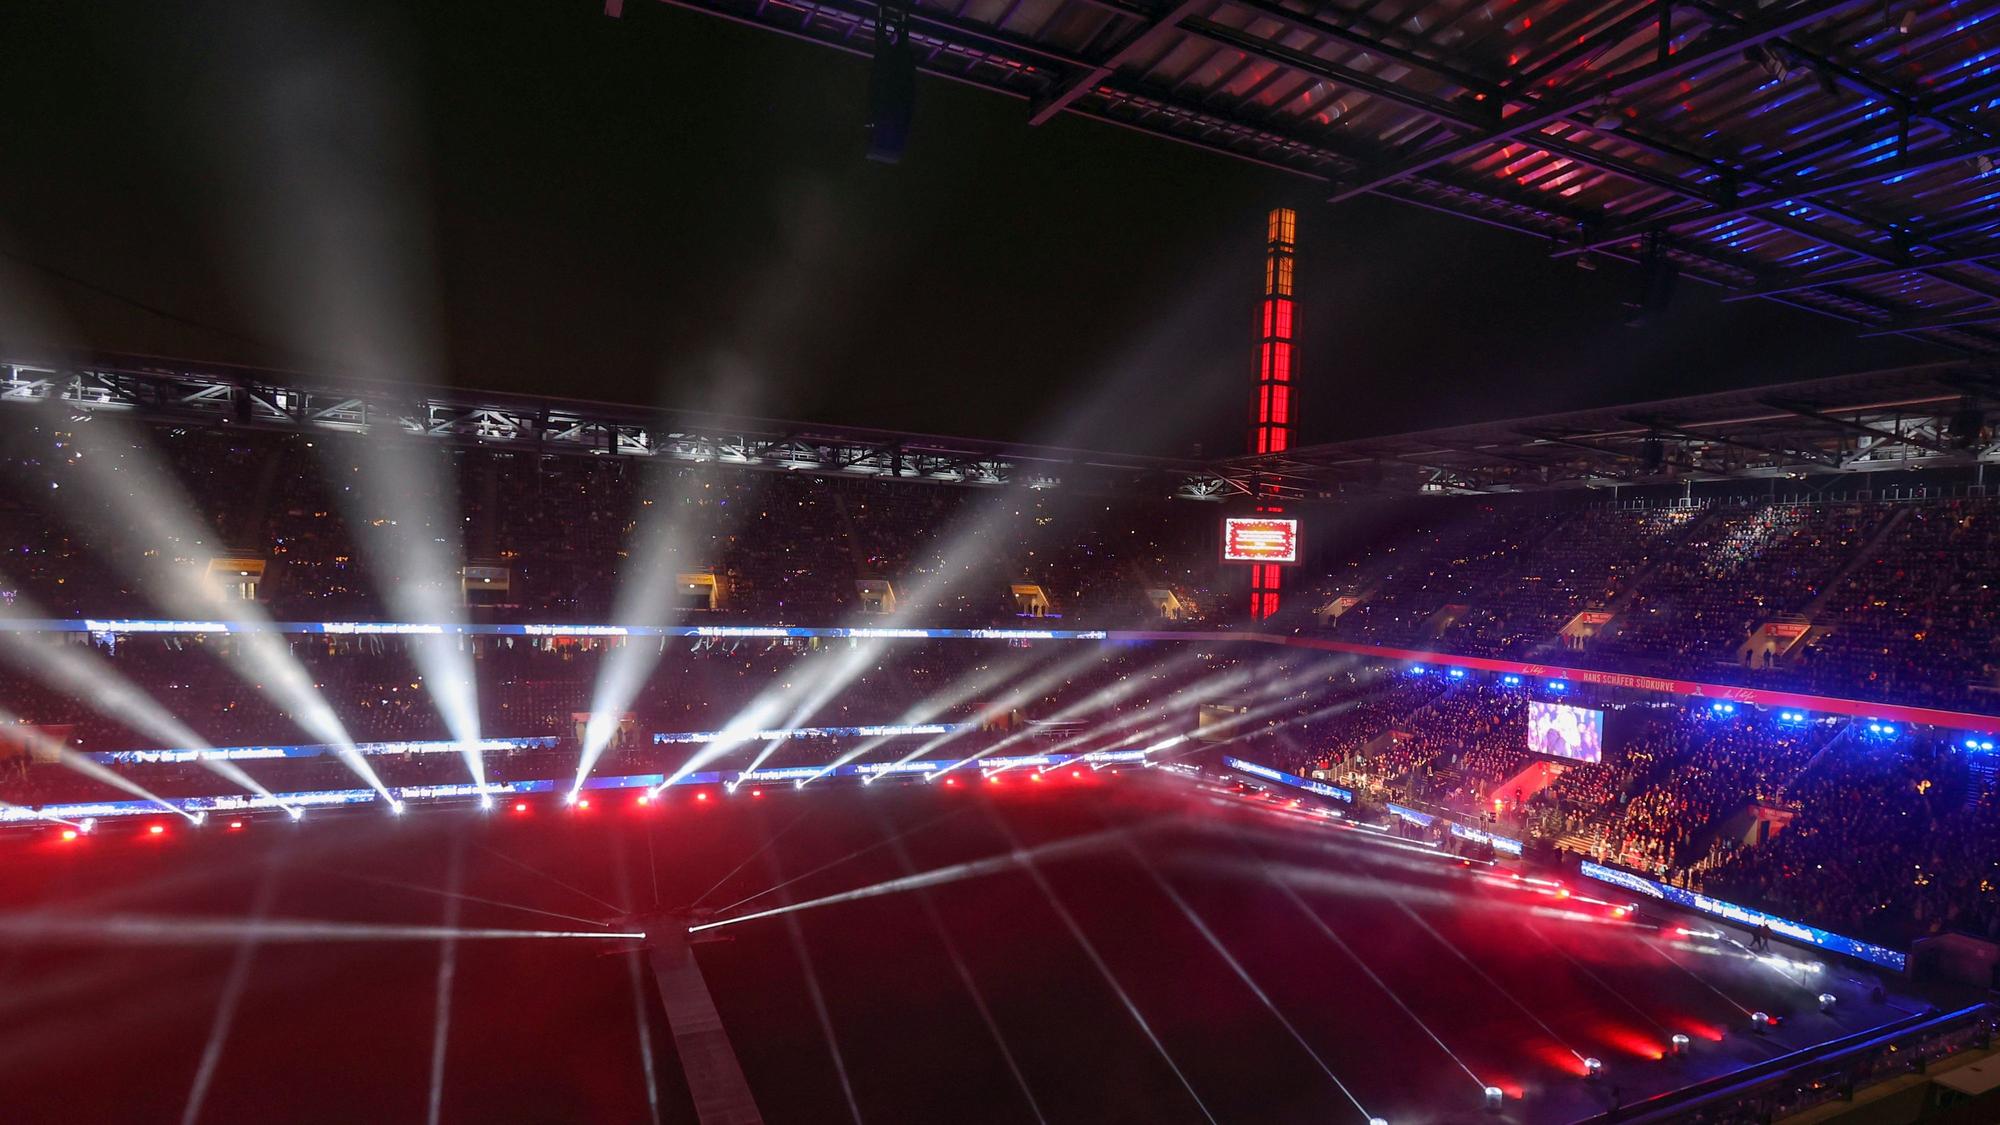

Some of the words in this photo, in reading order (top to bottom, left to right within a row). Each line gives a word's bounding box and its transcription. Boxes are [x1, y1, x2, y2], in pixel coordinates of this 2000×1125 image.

[1583, 673, 1601, 684] HANS
[1602, 674, 1634, 687] SCHÄFER
[1636, 677, 1675, 692] SÜDKURVE
